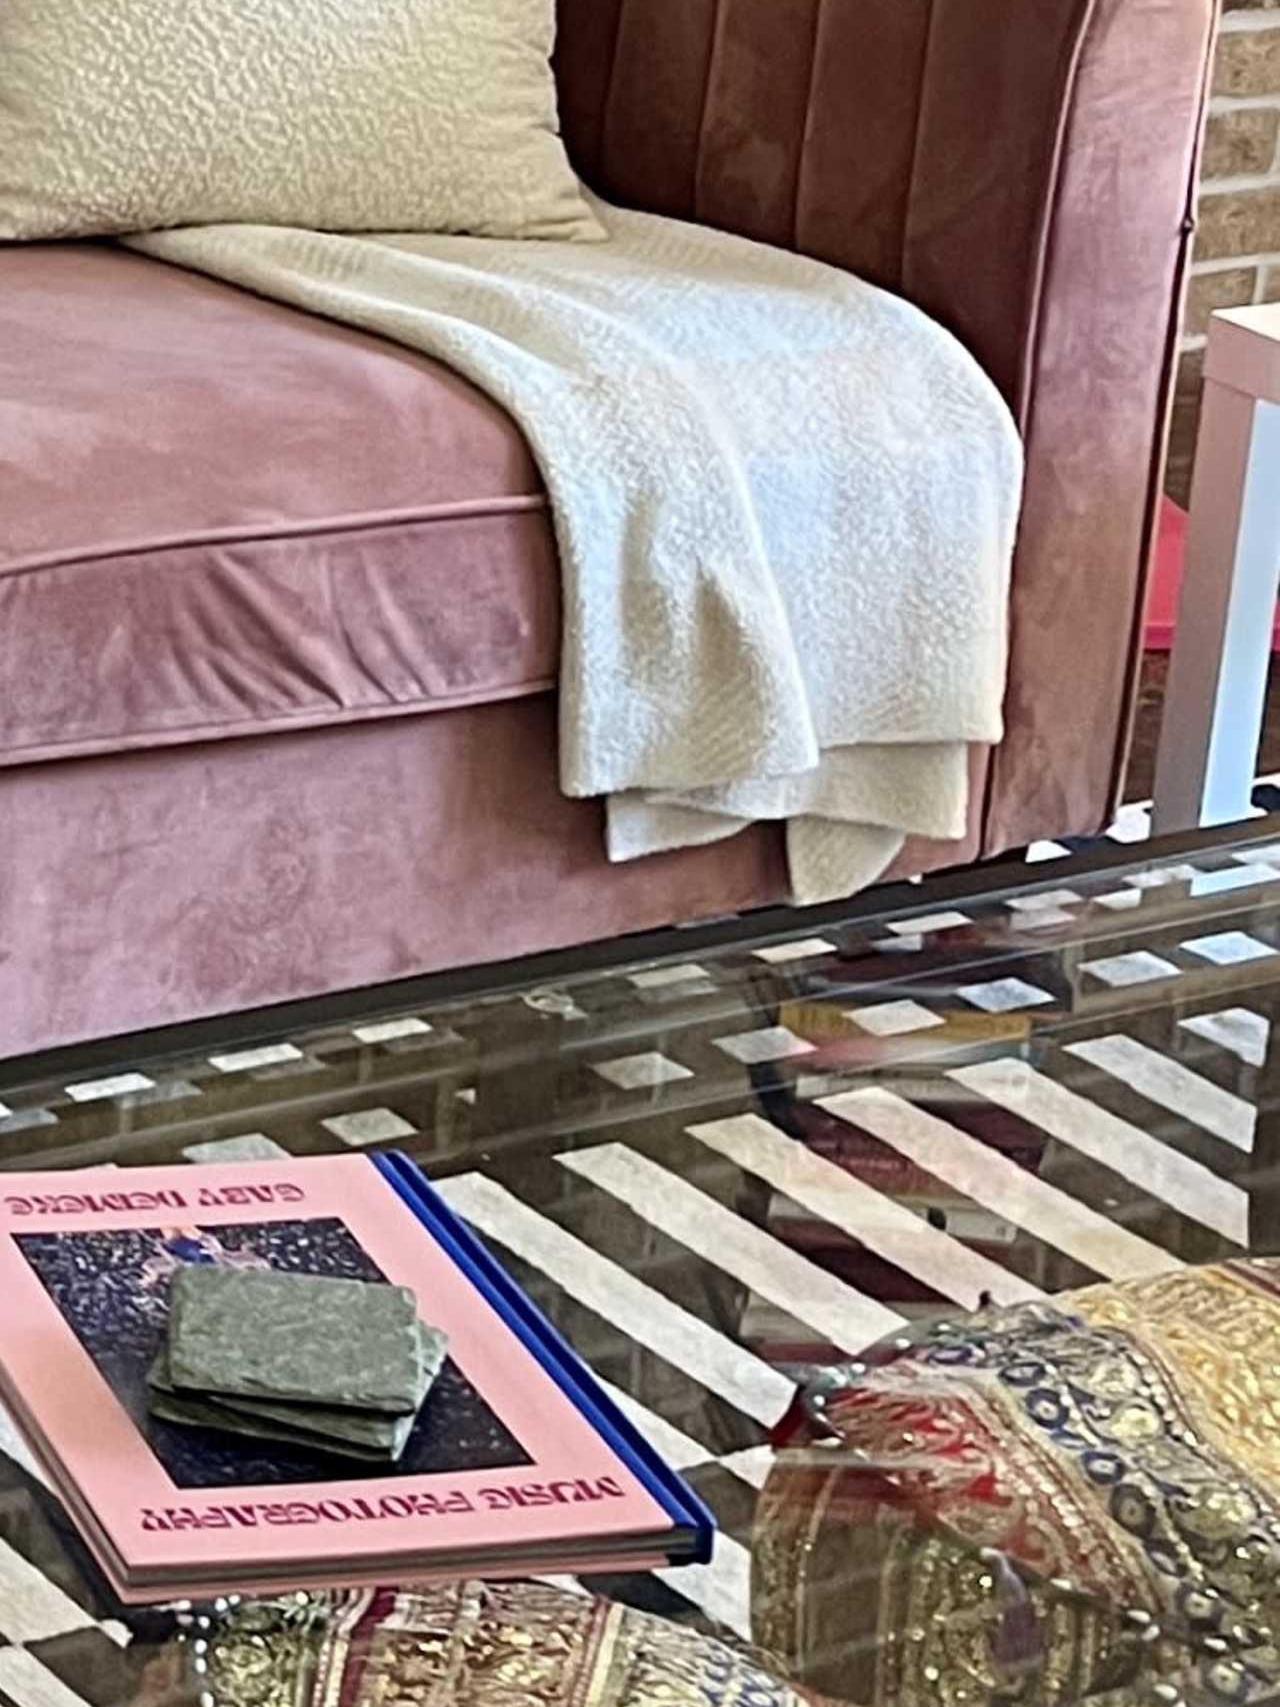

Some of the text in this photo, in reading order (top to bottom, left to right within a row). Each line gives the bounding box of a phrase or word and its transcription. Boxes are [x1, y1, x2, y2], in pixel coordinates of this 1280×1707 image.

[3, 1183, 306, 1216] GABY DEIMEKE
[139, 1475, 627, 1532] MUSIC PHOTOGRAPHY
